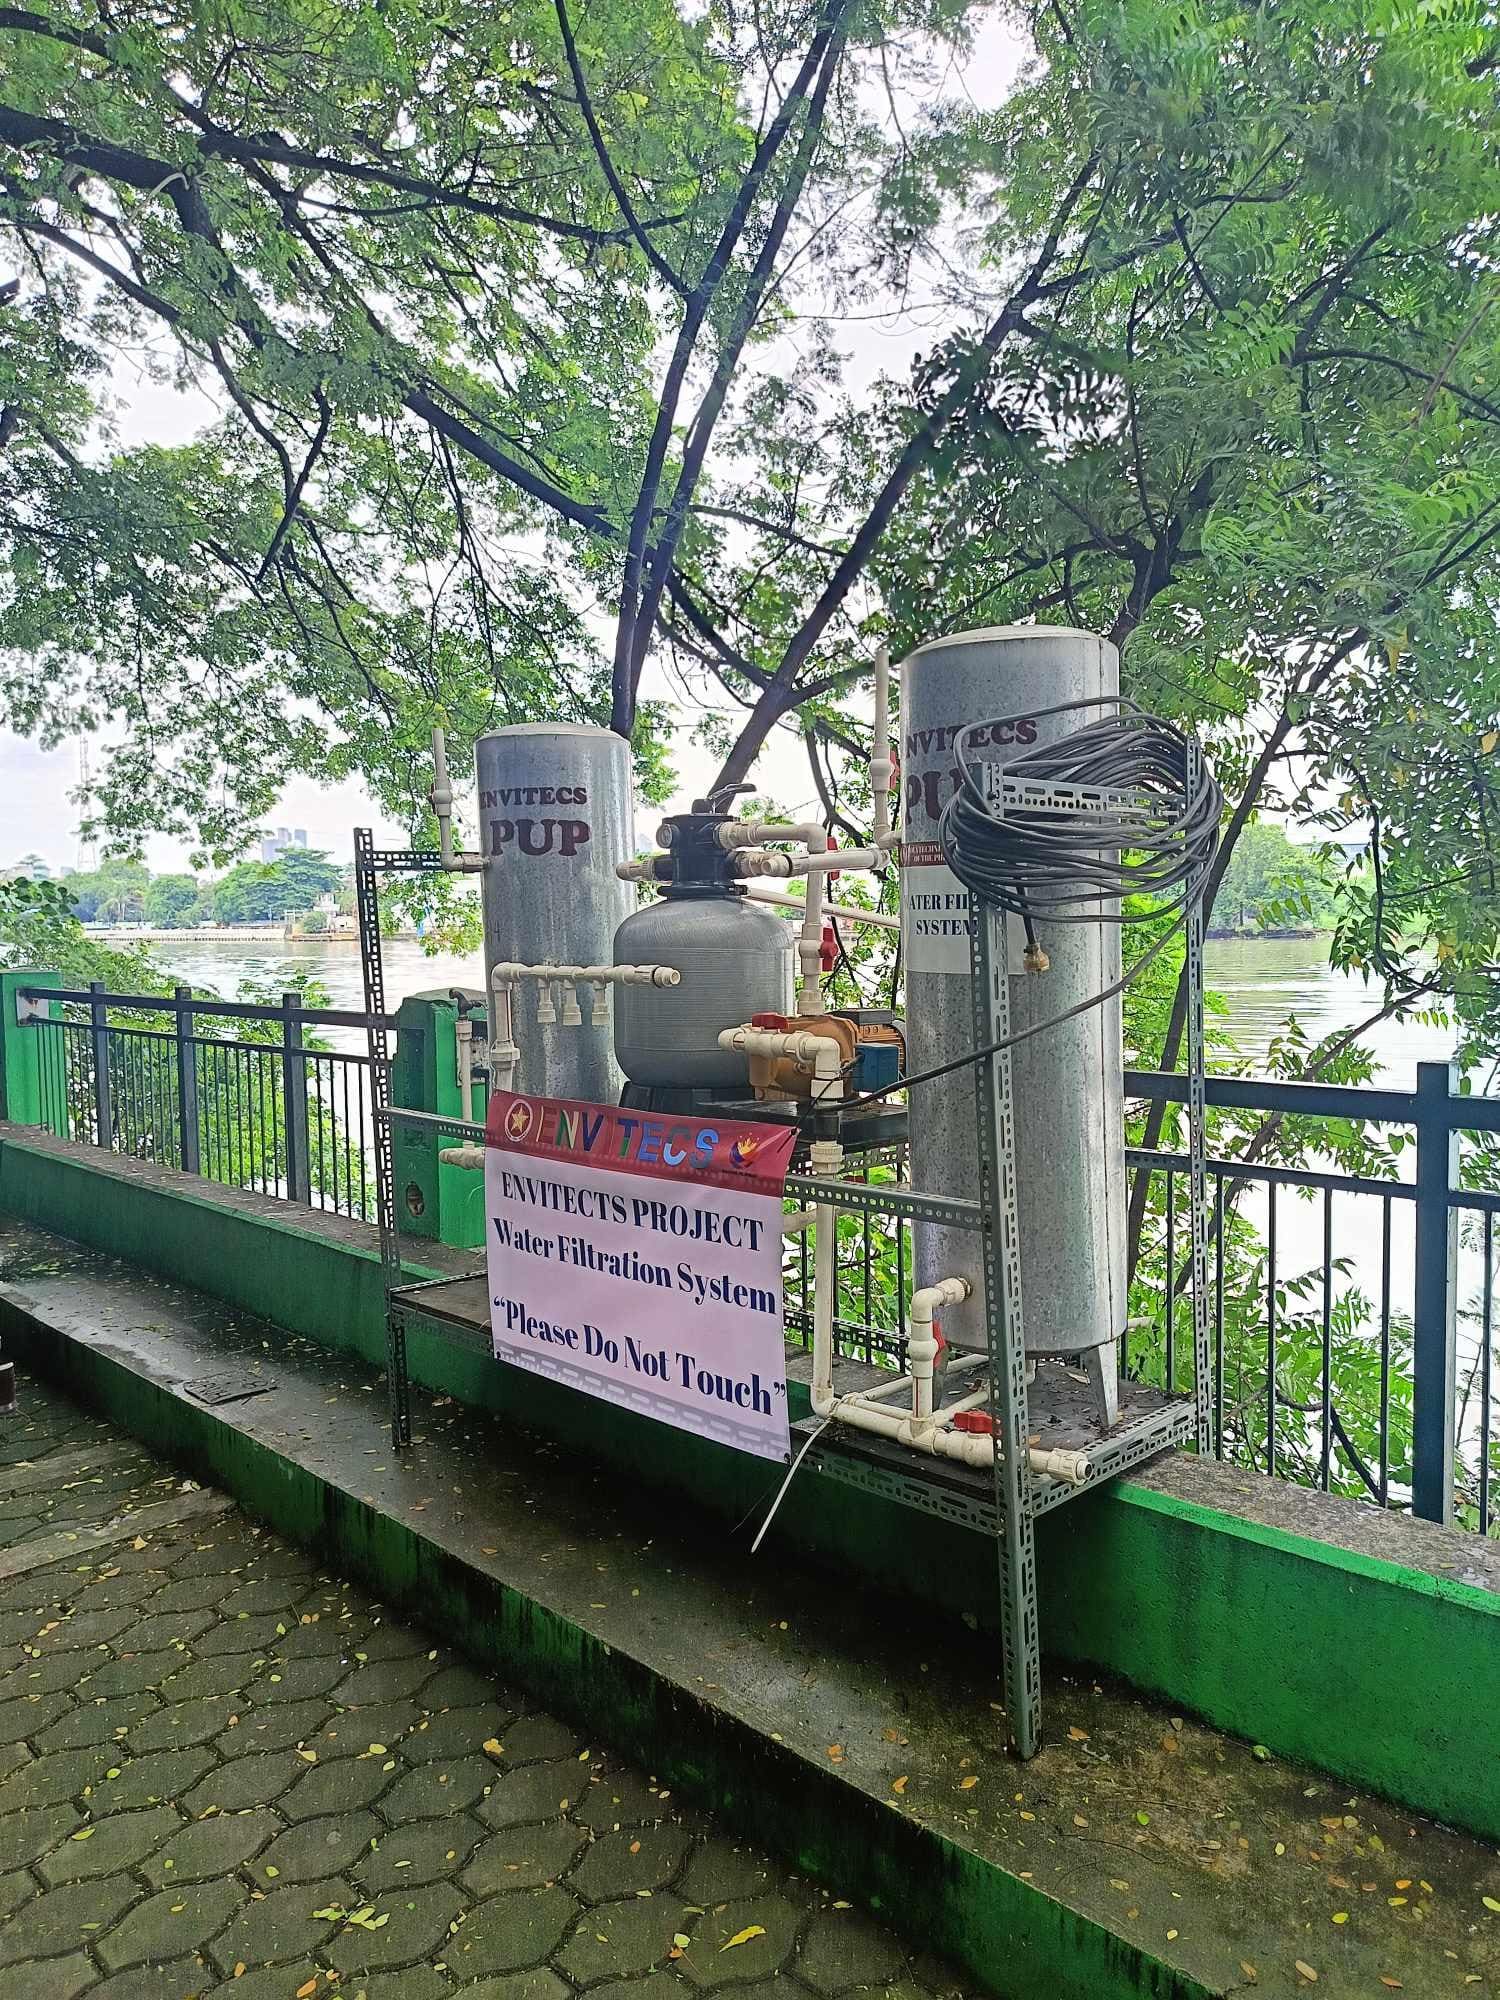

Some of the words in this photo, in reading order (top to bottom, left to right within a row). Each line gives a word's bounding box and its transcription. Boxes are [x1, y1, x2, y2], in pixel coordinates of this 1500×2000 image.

[490, 819, 590, 856] PUP
[502, 1170, 628, 1224] ENVITECTS
[632, 1198, 764, 1252] PROJECT
[492, 1217, 554, 1258] Water
[558, 1234, 672, 1288] Filtration
[677, 1262, 776, 1315] System
[584, 1324, 619, 1364] Do
[624, 1335, 671, 1382] Not
